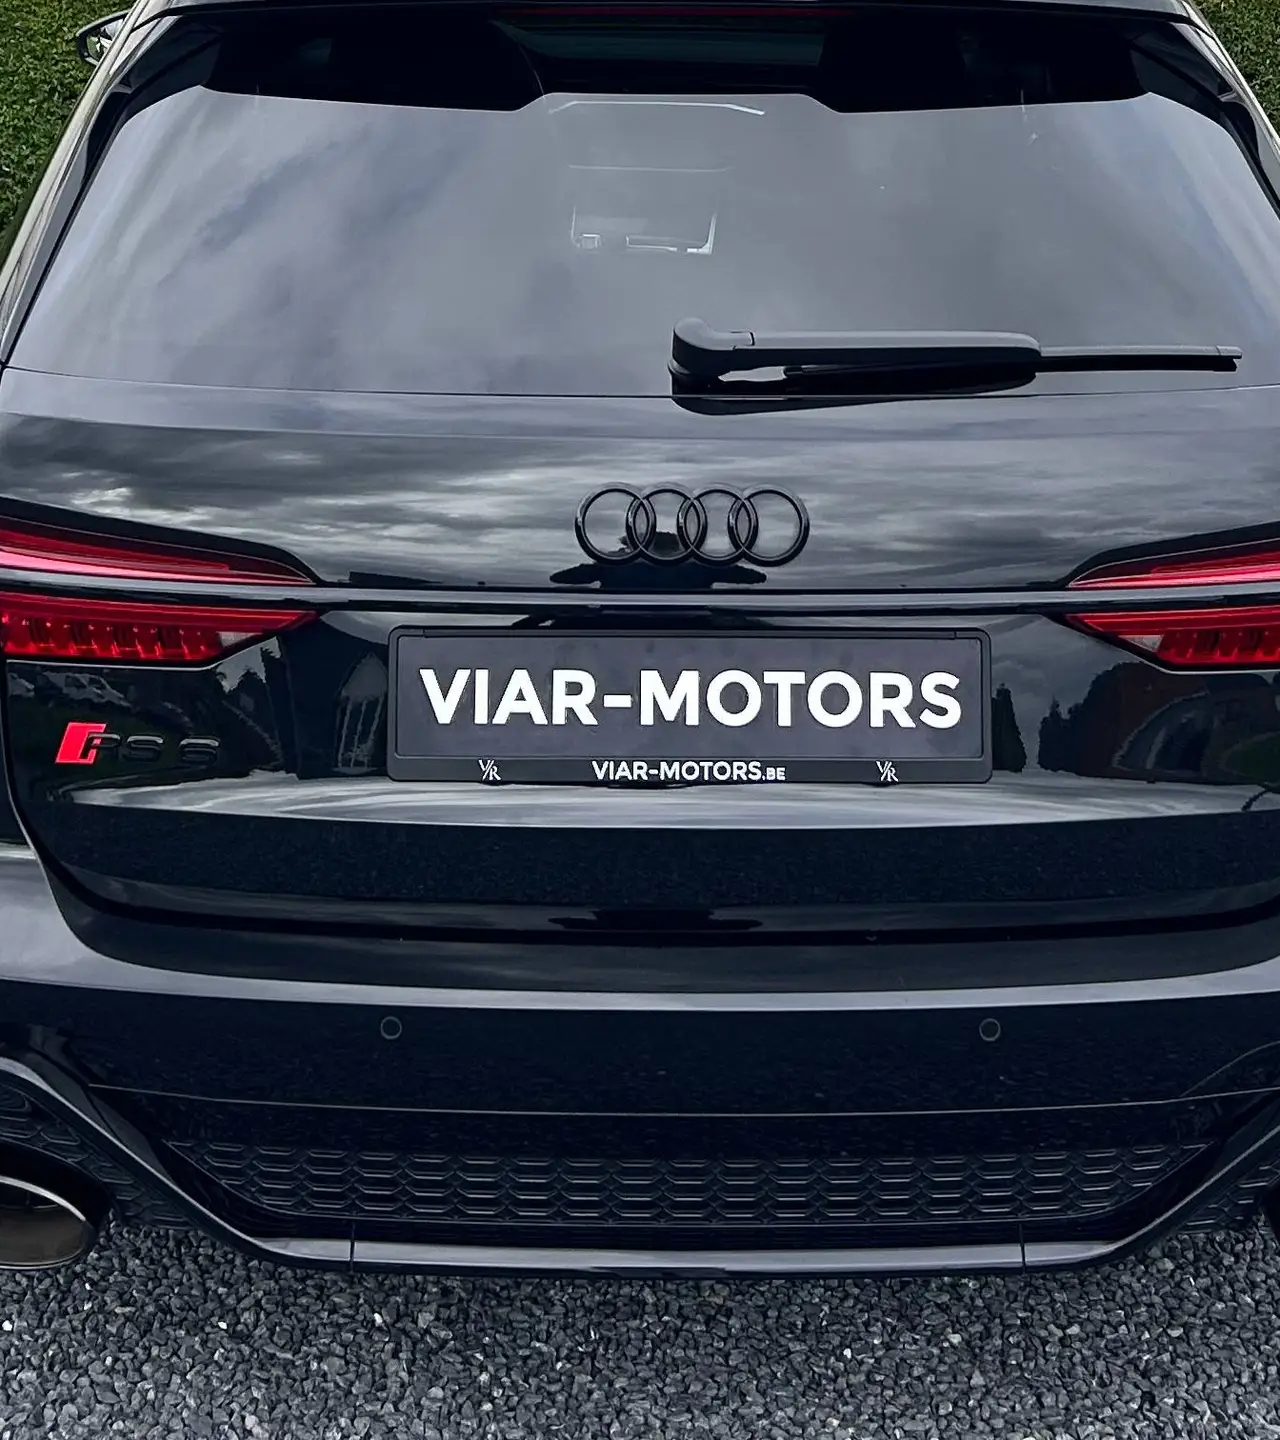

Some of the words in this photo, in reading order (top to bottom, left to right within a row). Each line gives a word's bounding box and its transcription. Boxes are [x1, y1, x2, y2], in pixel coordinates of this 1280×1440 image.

[420, 668, 962, 729] VIAR-MOTORS
[78, 732, 165, 763] RS
[591, 760, 786, 782] VIAR-MOTORS.BE
